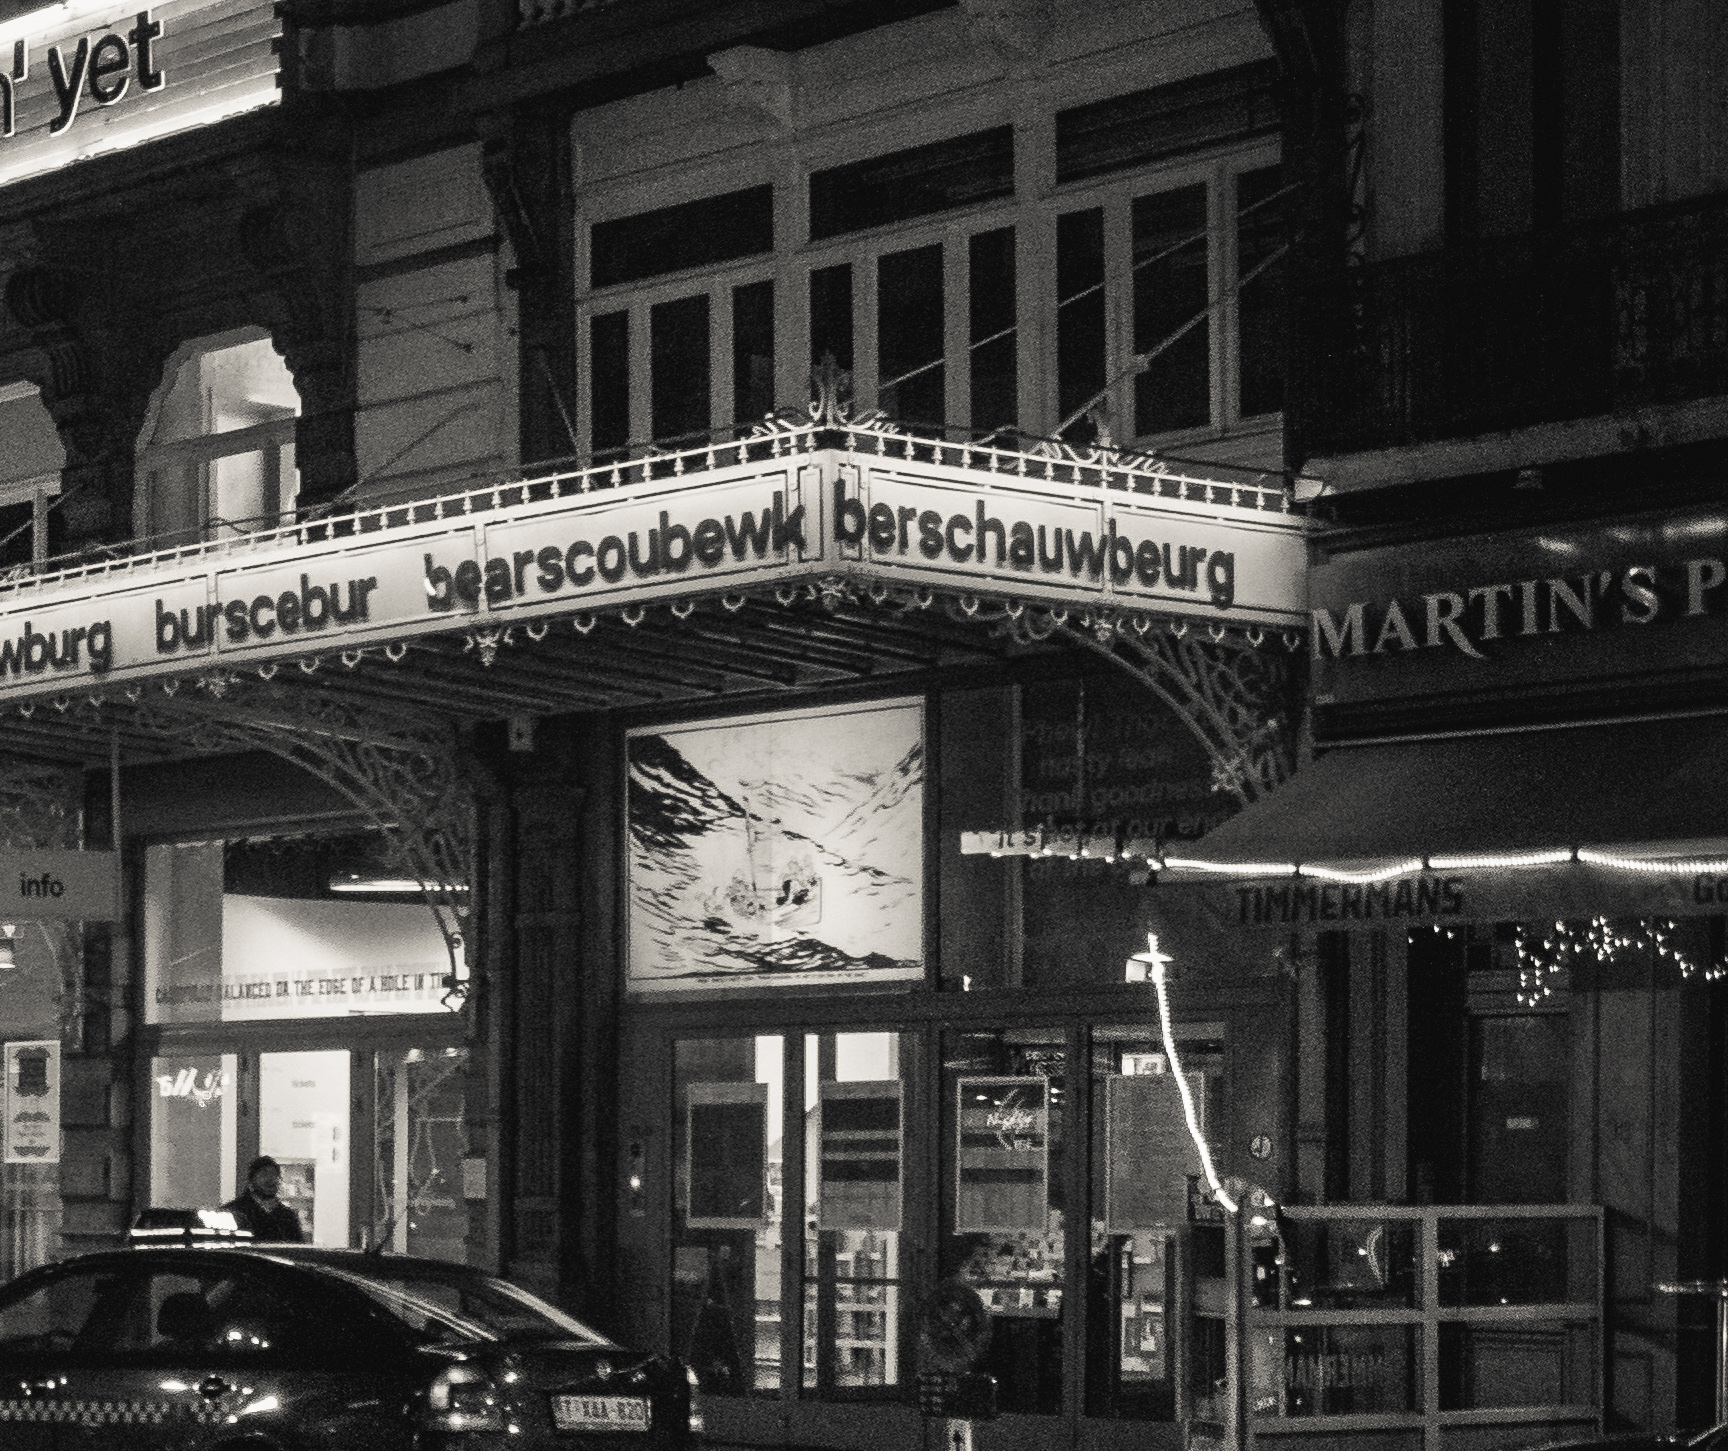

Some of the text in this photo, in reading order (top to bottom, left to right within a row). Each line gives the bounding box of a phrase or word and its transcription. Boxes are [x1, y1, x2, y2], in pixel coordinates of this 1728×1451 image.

[48, 9, 166, 135] yet
[832, 482, 1236, 609] berschauwbeurg
[154, 567, 378, 656] burscebur
[1310, 565, 1661, 661] MARTIN'S
[19, 871, 66, 898] info
[1236, 877, 1465, 925] TIMMERMANS
